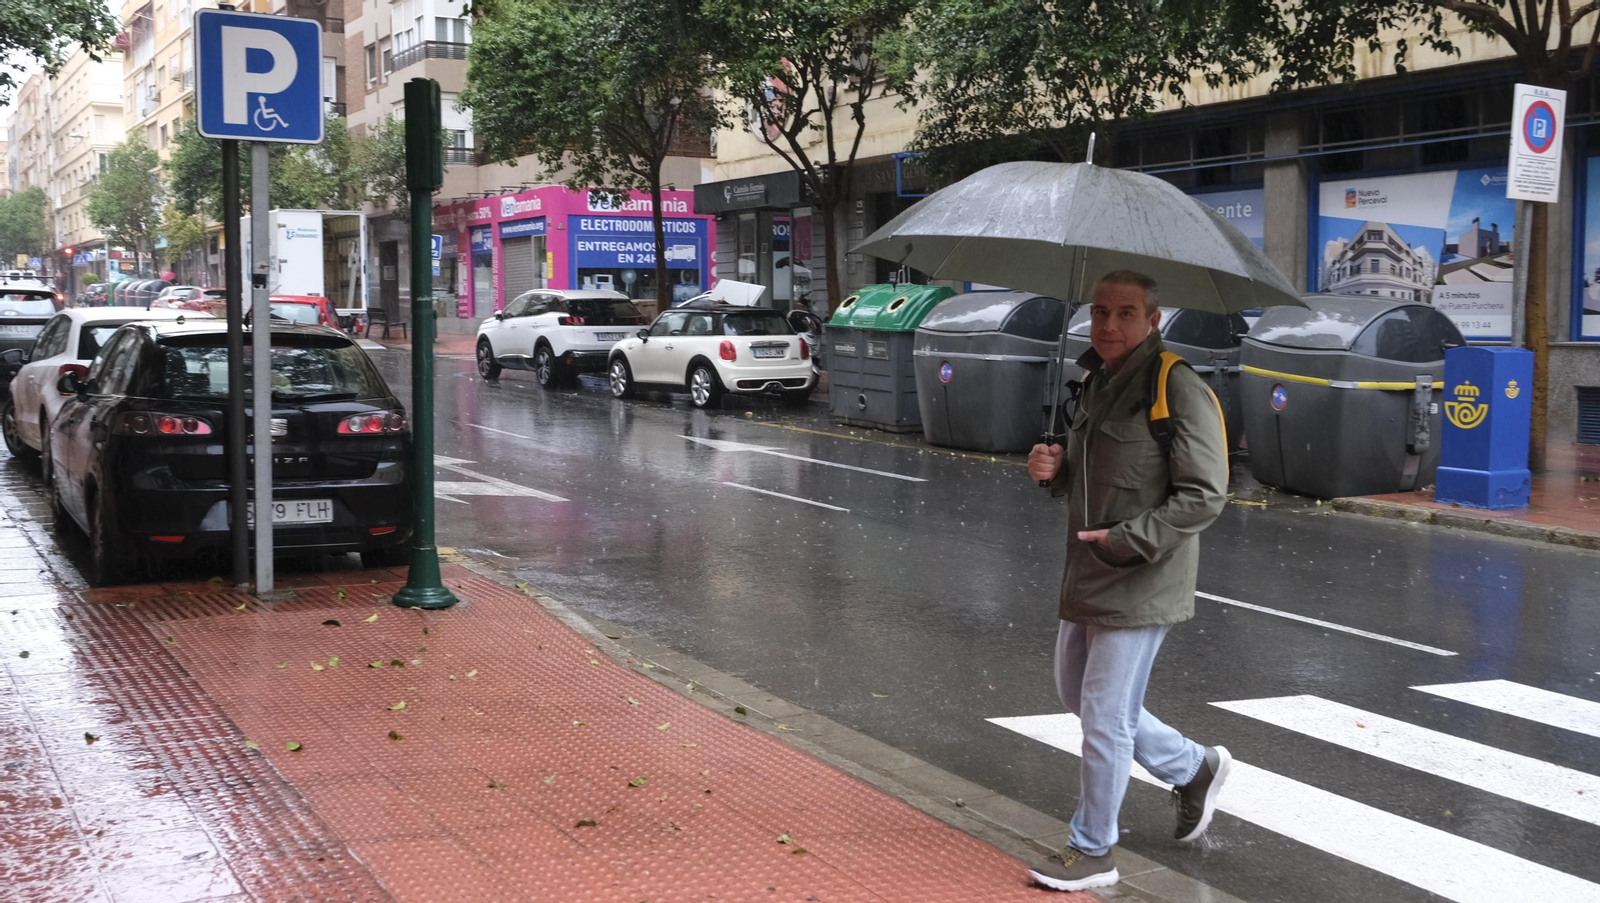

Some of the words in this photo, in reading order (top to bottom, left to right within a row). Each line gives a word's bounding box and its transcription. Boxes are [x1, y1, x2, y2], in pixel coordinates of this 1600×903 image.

[221, 25, 298, 125] P
[1358, 189, 1380, 197] Nuevo
[580, 219, 696, 233] ELECTRODOMSTICOS
[617, 253, 634, 263] EN
[1451, 291, 1481, 299] minutos
[1449, 302, 1471, 310] Puerta
[1471, 301, 1505, 310] Purchena
[1461, 321, 1470, 329] 99
[1482, 321, 1492, 329] 44
[297, 502, 328, 518] FLH
